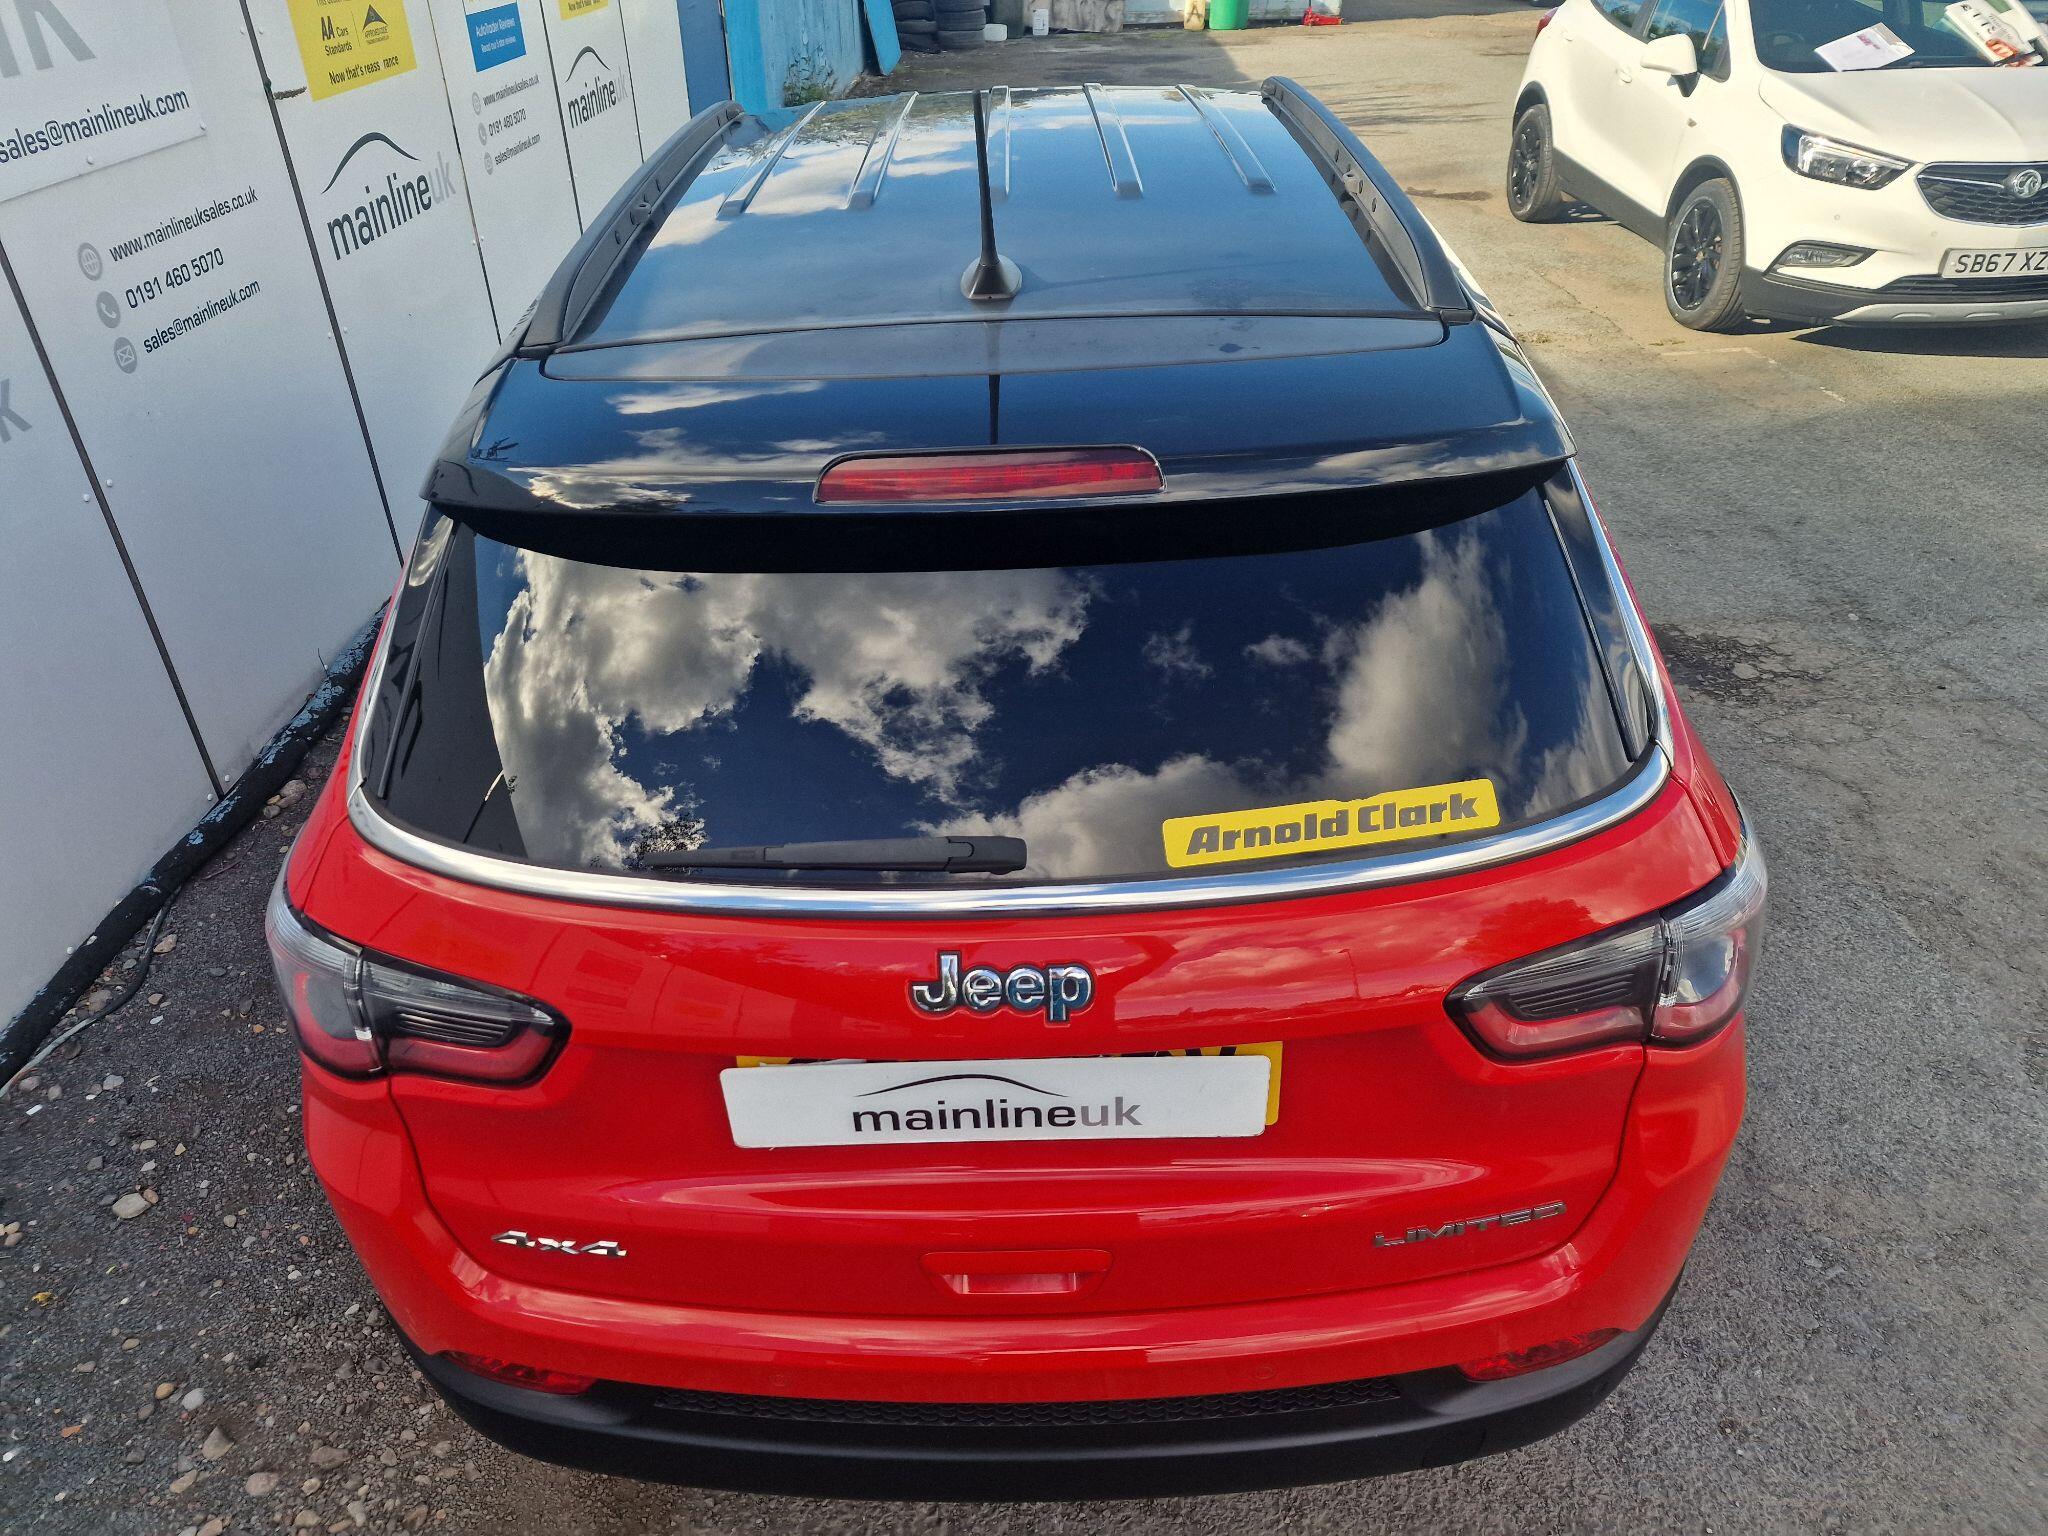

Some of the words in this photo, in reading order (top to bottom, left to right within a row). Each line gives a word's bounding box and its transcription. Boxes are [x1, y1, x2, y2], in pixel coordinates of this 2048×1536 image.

[321, 16, 336, 41] AA
[336, 26, 349, 37] Cars
[325, 41, 352, 56] Standards
[329, 71, 345, 85] Now
[345, 64, 365, 81] that's
[0, 90, 190, 163] sales@mainlineuk.com
[489, 119, 502, 136] 0191
[503, 114, 514, 128] 460
[513, 108, 527, 124] 5070
[109, 185, 259, 262] www.mainlineuksales.co.uk
[327, 151, 456, 260] mainlineuk
[125, 277, 163, 309] 0191
[165, 263, 191, 289] 460
[191, 248, 224, 277] 5070
[1955, 253, 2017, 273] SB67
[2019, 251, 2048, 271] XZ
[143, 280, 261, 353] sales@mainlineuk.com
[1185, 809, 1350, 856] Arnold
[1357, 793, 1480, 834] Clark
[910, 950, 1094, 1023] Jeep
[853, 1096, 1143, 1133] mainlineuk
[1373, 1201, 1567, 1248] LIMITED
